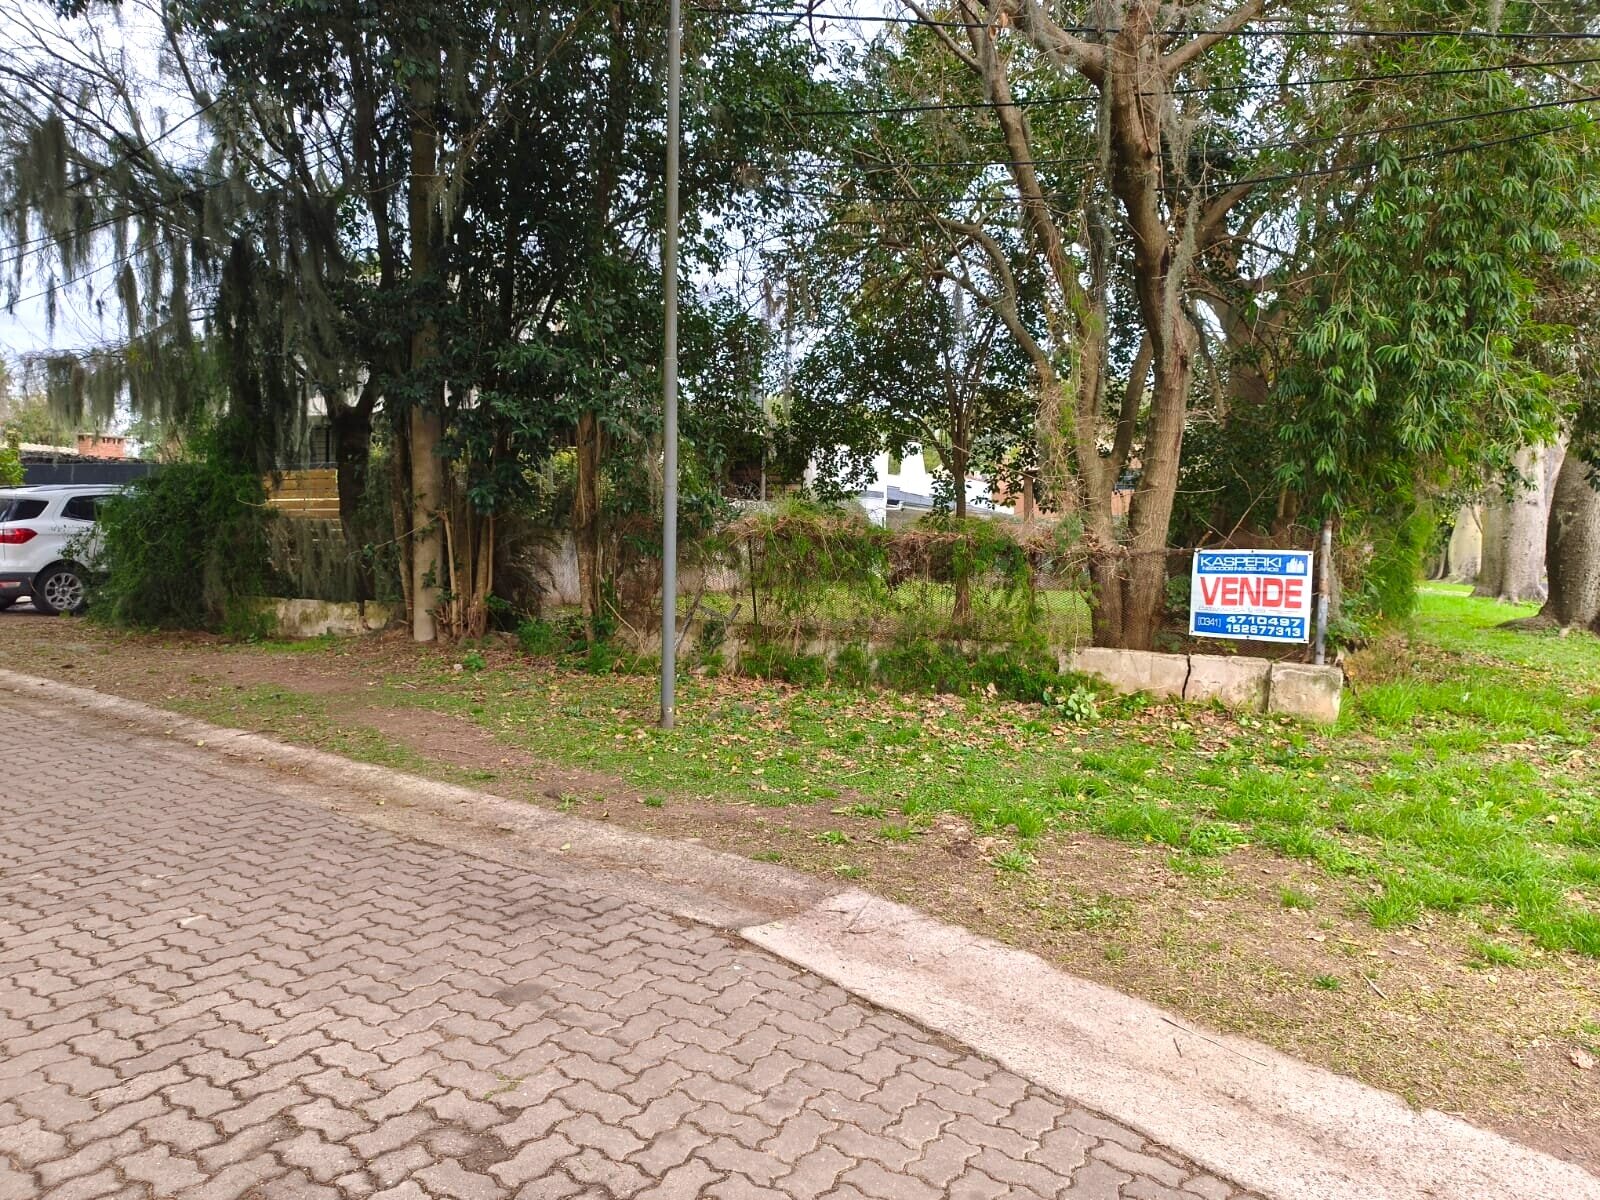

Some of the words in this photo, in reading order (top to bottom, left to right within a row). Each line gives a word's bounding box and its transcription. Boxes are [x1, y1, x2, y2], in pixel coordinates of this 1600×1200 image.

[1200, 556, 1282, 568] KASPERKI
[1200, 576, 1303, 608] VENDE
[1226, 615, 1301, 627] 4710497
